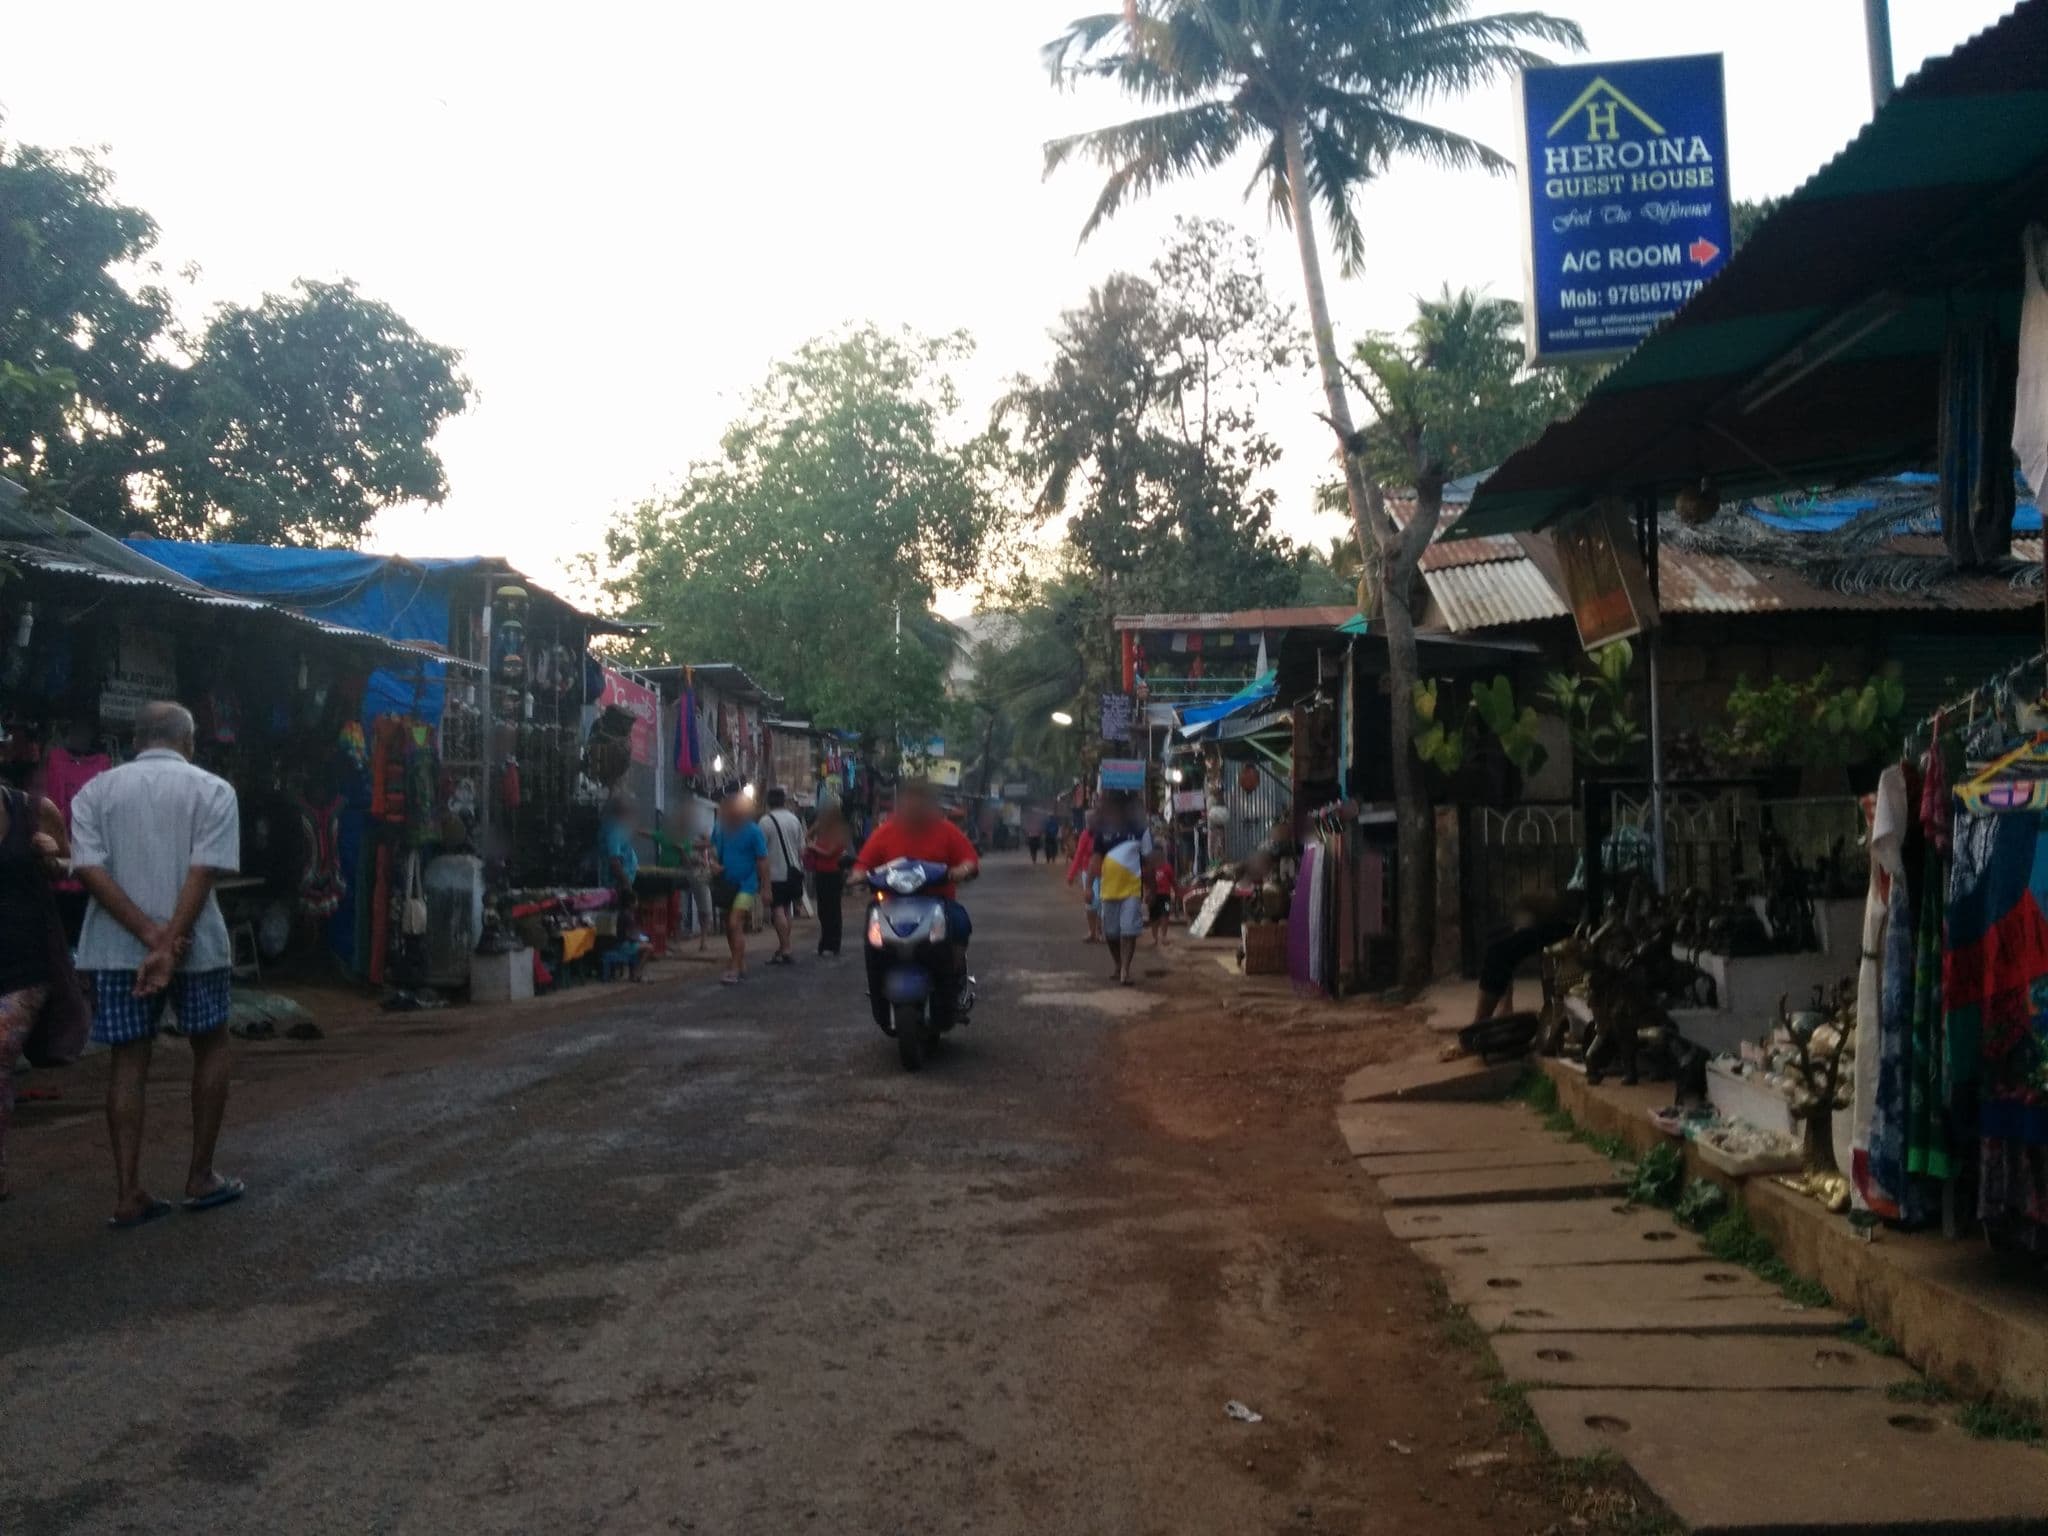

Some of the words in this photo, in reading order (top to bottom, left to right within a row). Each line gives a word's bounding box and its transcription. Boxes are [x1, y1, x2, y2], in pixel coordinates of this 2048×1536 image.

[1586, 101, 1620, 141] H
[1544, 135, 1713, 175] HEROINA
[1545, 173, 1625, 199] GUEST
[1631, 166, 1715, 192] HOUSE
[1561, 249, 1602, 273] A/C
[1608, 243, 1682, 270] ROOM
[1560, 287, 1602, 309] Mob:
